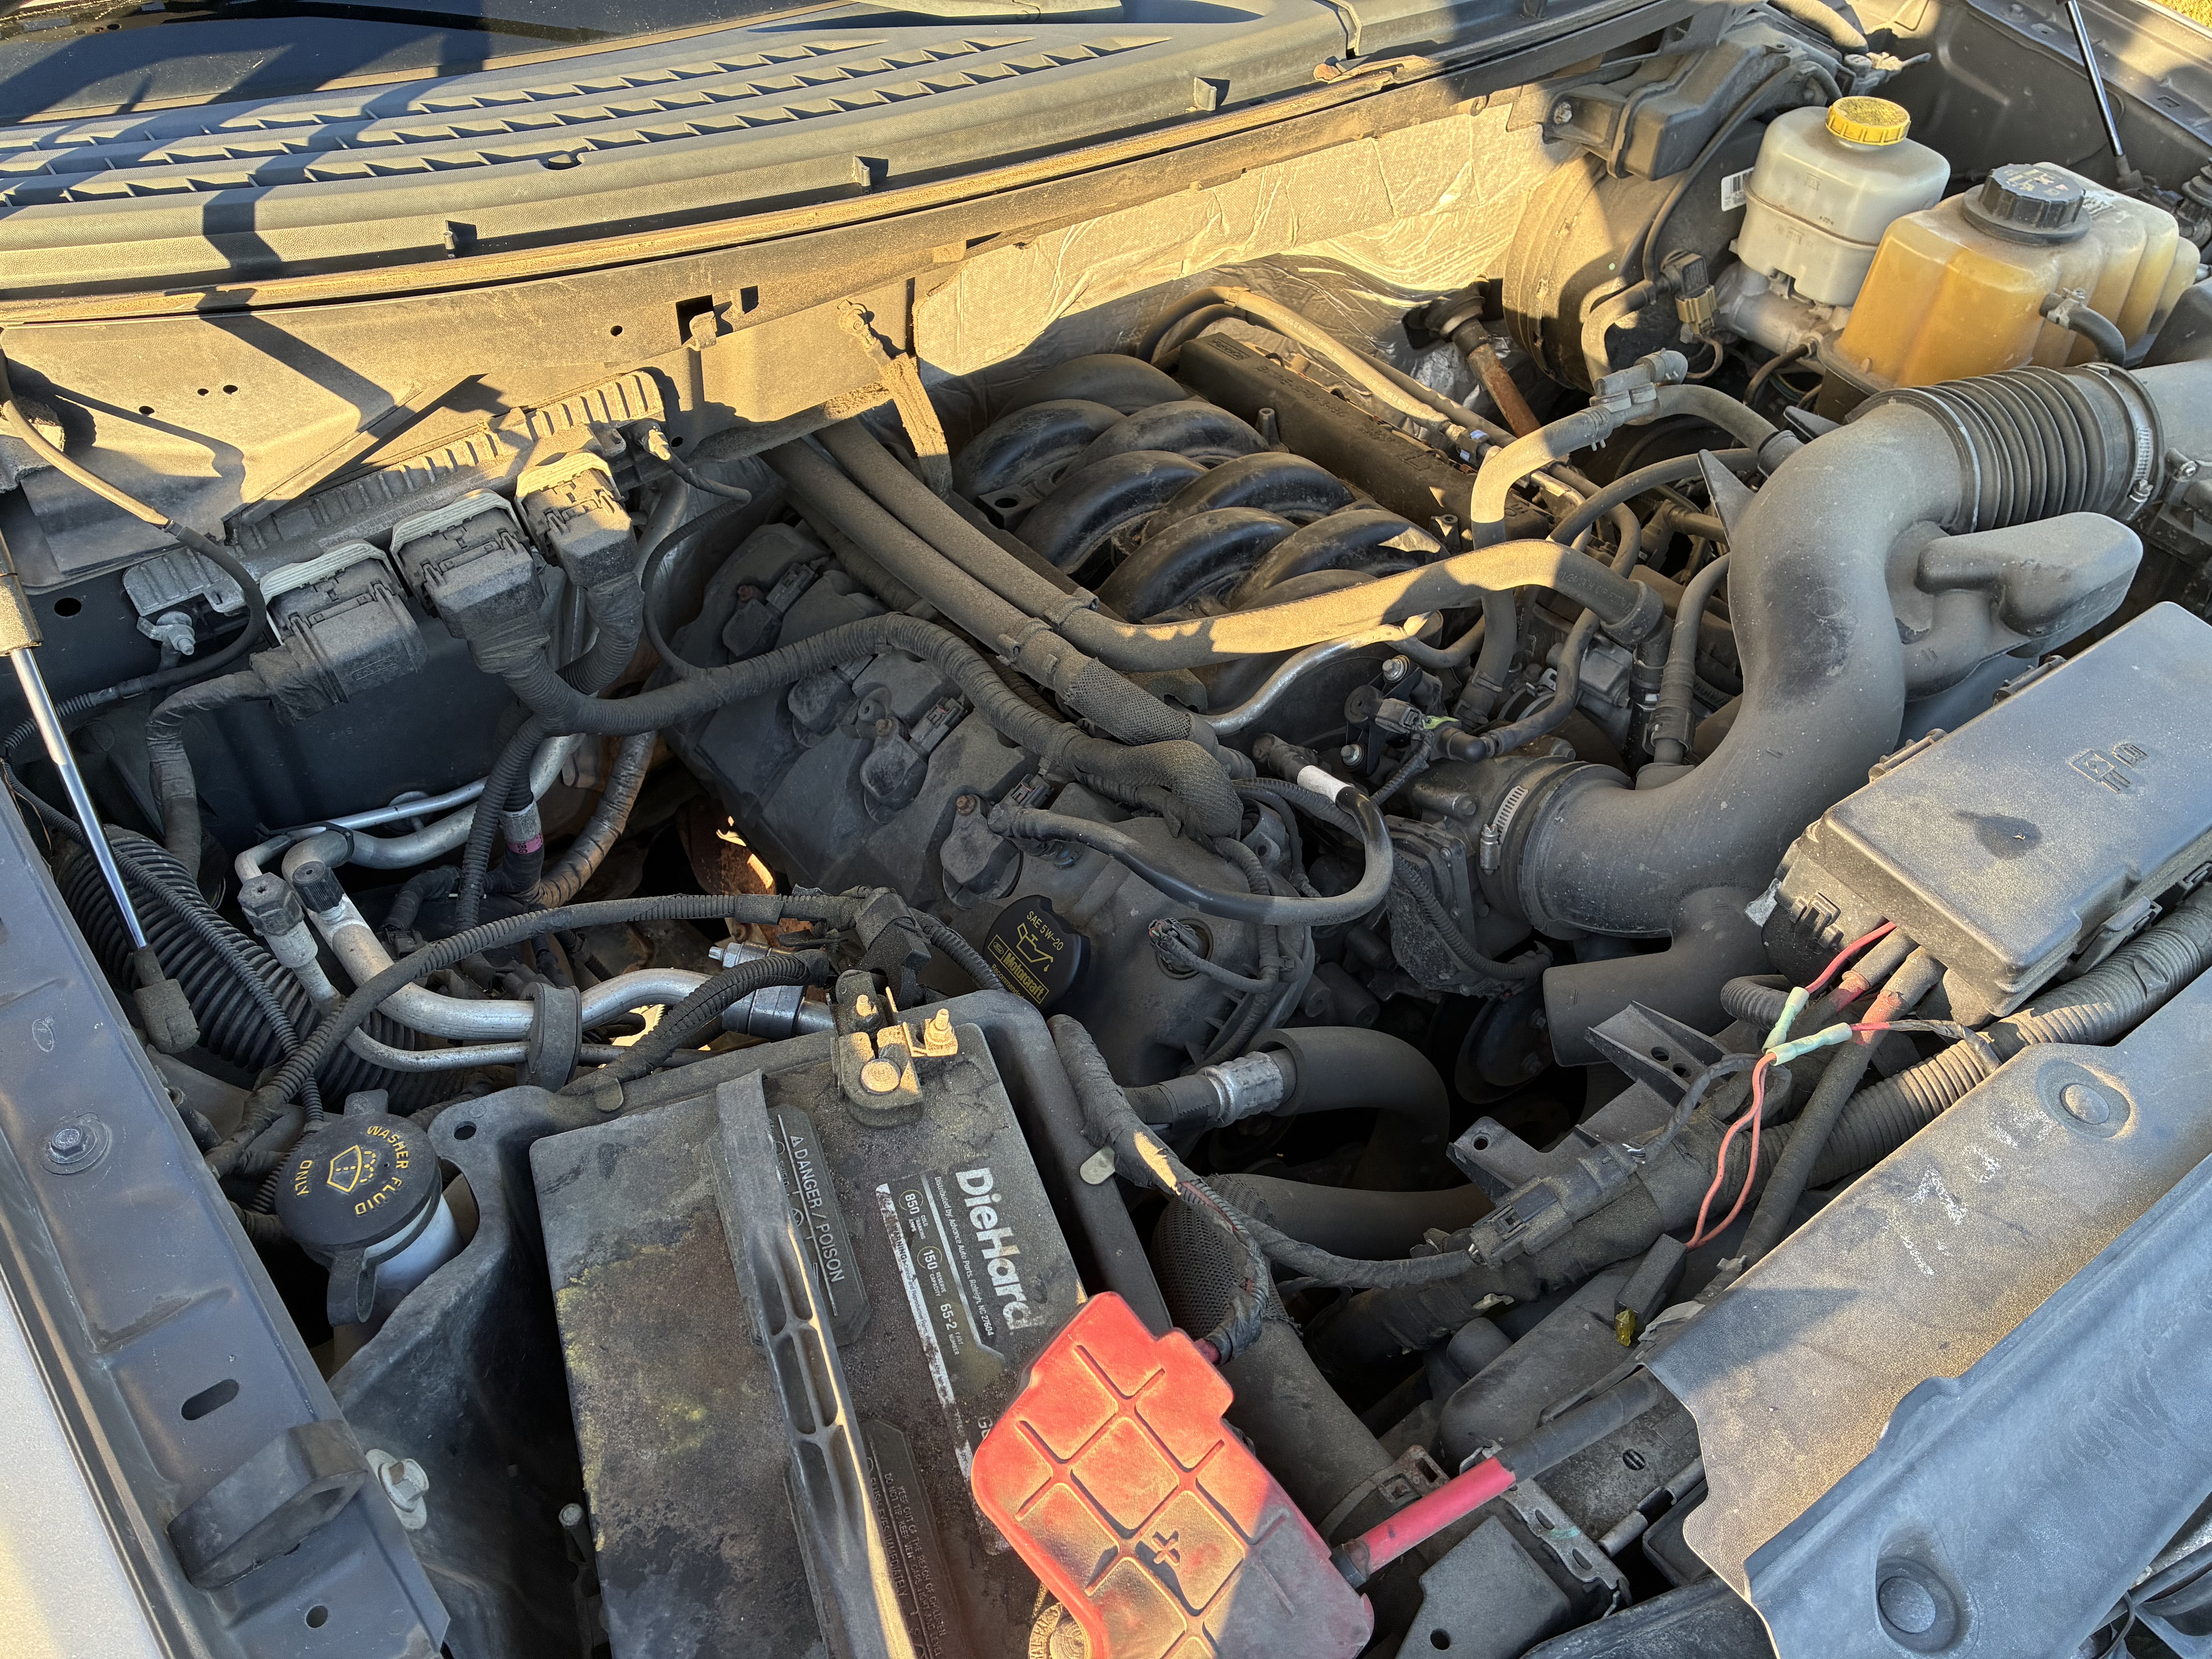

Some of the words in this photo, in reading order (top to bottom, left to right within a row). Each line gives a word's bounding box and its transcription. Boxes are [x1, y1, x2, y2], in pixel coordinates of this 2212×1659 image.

[1027, 911, 1042, 929] SAE
[1040, 924, 1064, 951] 5W-20
[1003, 952, 1045, 1000] Motorcraft
[367, 1126, 409, 1169] WASHER
[295, 1160, 313, 1196] ONLY
[355, 1177, 402, 1215] FLUID
[904, 1192, 920, 1215] 850
[934, 1176, 952, 1209] Distributed
[794, 1149, 823, 1209] DANGER
[816, 1223, 845, 1283] POISON
[907, 1218, 917, 1232] AMPS
[920, 1214, 928, 1227] COLD
[948, 1217, 963, 1245] Advance
[922, 1249, 939, 1271] 150
[955, 1167, 1040, 1331] DieHard
[957, 1243, 969, 1260] Auto
[928, 1273, 941, 1297] CAPACITY
[934, 1271, 947, 1293] RESERVE
[910, 1290, 925, 1320] Reproductive
[939, 1302, 958, 1331] 65-2
[977, 1304, 987, 1315] NC
[981, 1314, 994, 1336] 27604
[948, 1333, 960, 1356] NUMBER
[883, 1472, 894, 1484] DO
[902, 1506, 915, 1523] OUT
